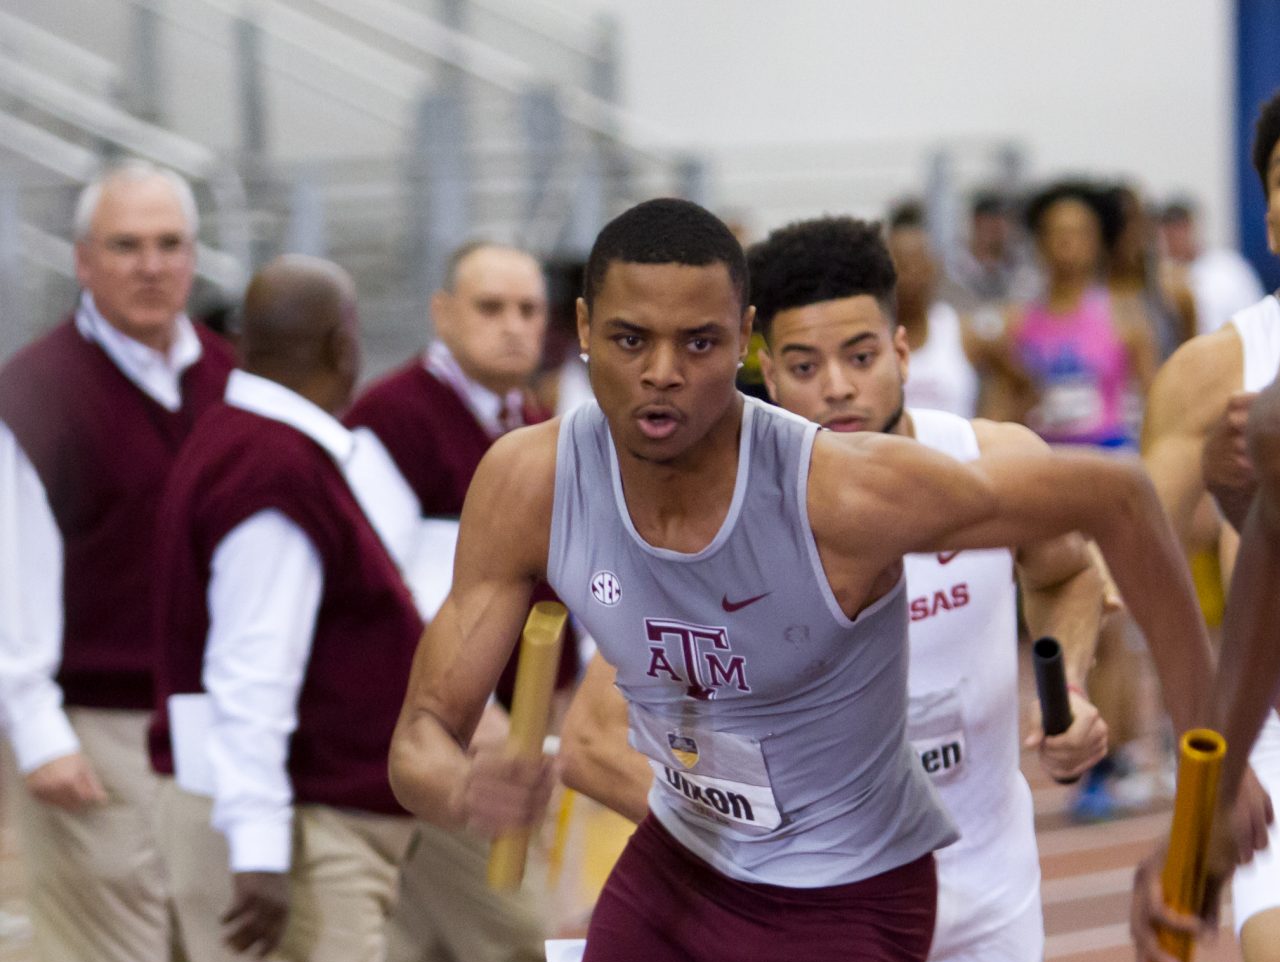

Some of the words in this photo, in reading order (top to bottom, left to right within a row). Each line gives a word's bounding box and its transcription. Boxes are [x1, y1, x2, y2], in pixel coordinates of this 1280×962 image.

[590, 570, 623, 606] SEC
[907, 583, 971, 622] SAS
[921, 741, 962, 775] en
